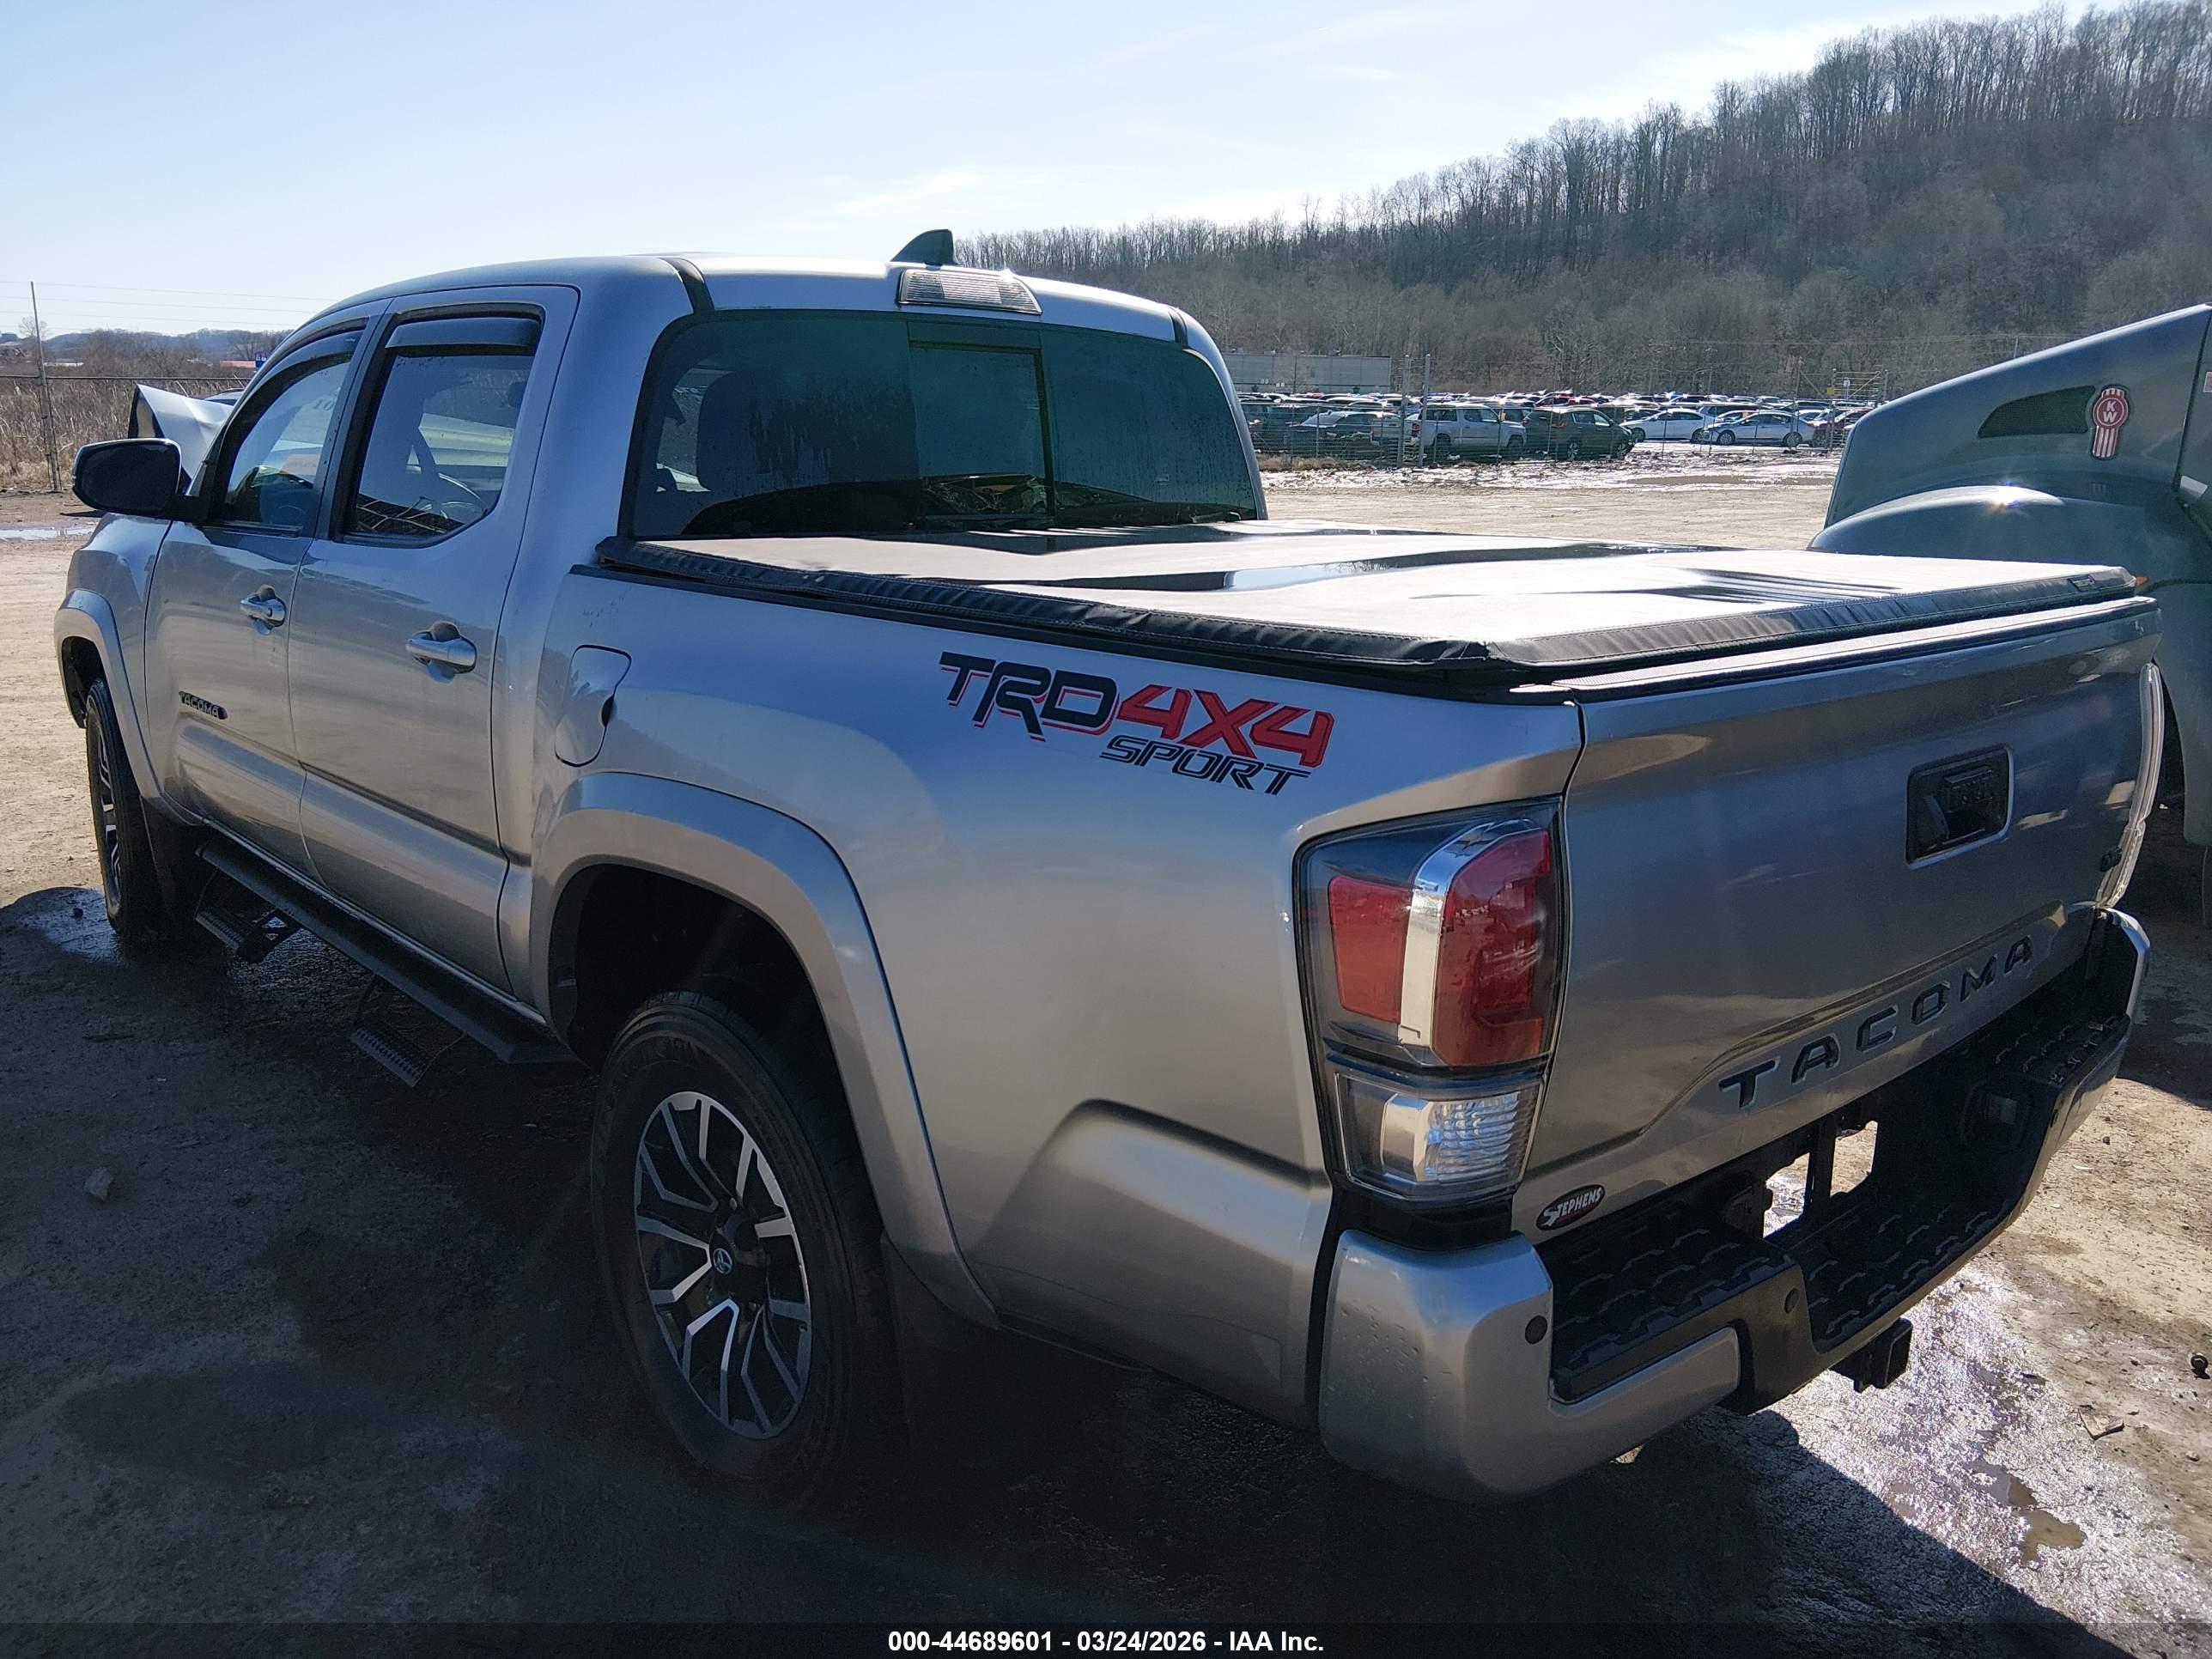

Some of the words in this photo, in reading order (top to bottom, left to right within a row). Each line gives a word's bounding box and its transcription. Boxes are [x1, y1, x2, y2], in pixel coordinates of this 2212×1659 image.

[939, 652, 1120, 742] TRD
[1099, 735, 1311, 796] SPORT
[1718, 935, 2033, 1109] TACOMA
[1540, 1187, 1603, 1227] STEPHENS
